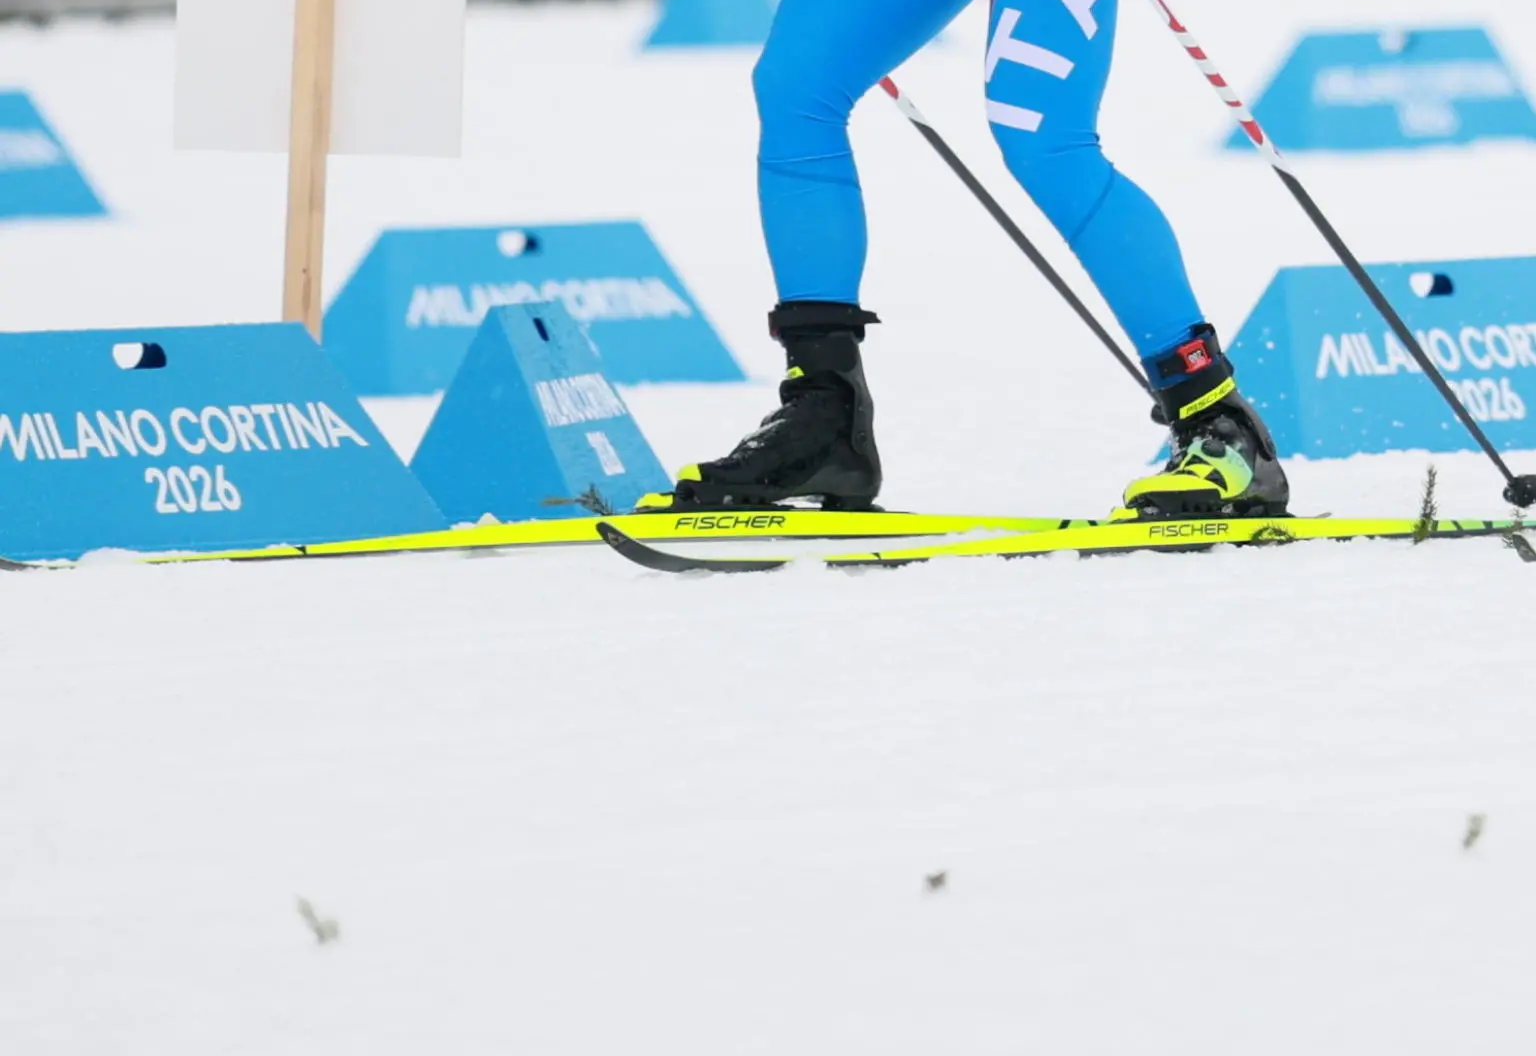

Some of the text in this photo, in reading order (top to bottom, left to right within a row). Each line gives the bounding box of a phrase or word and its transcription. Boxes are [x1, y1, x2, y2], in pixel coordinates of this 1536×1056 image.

[0, 401, 370, 461] MILANO CORTINA
[144, 464, 242, 514] 2026
[674, 515, 786, 531] FISCHER
[1149, 522, 1229, 539] FISCHER
